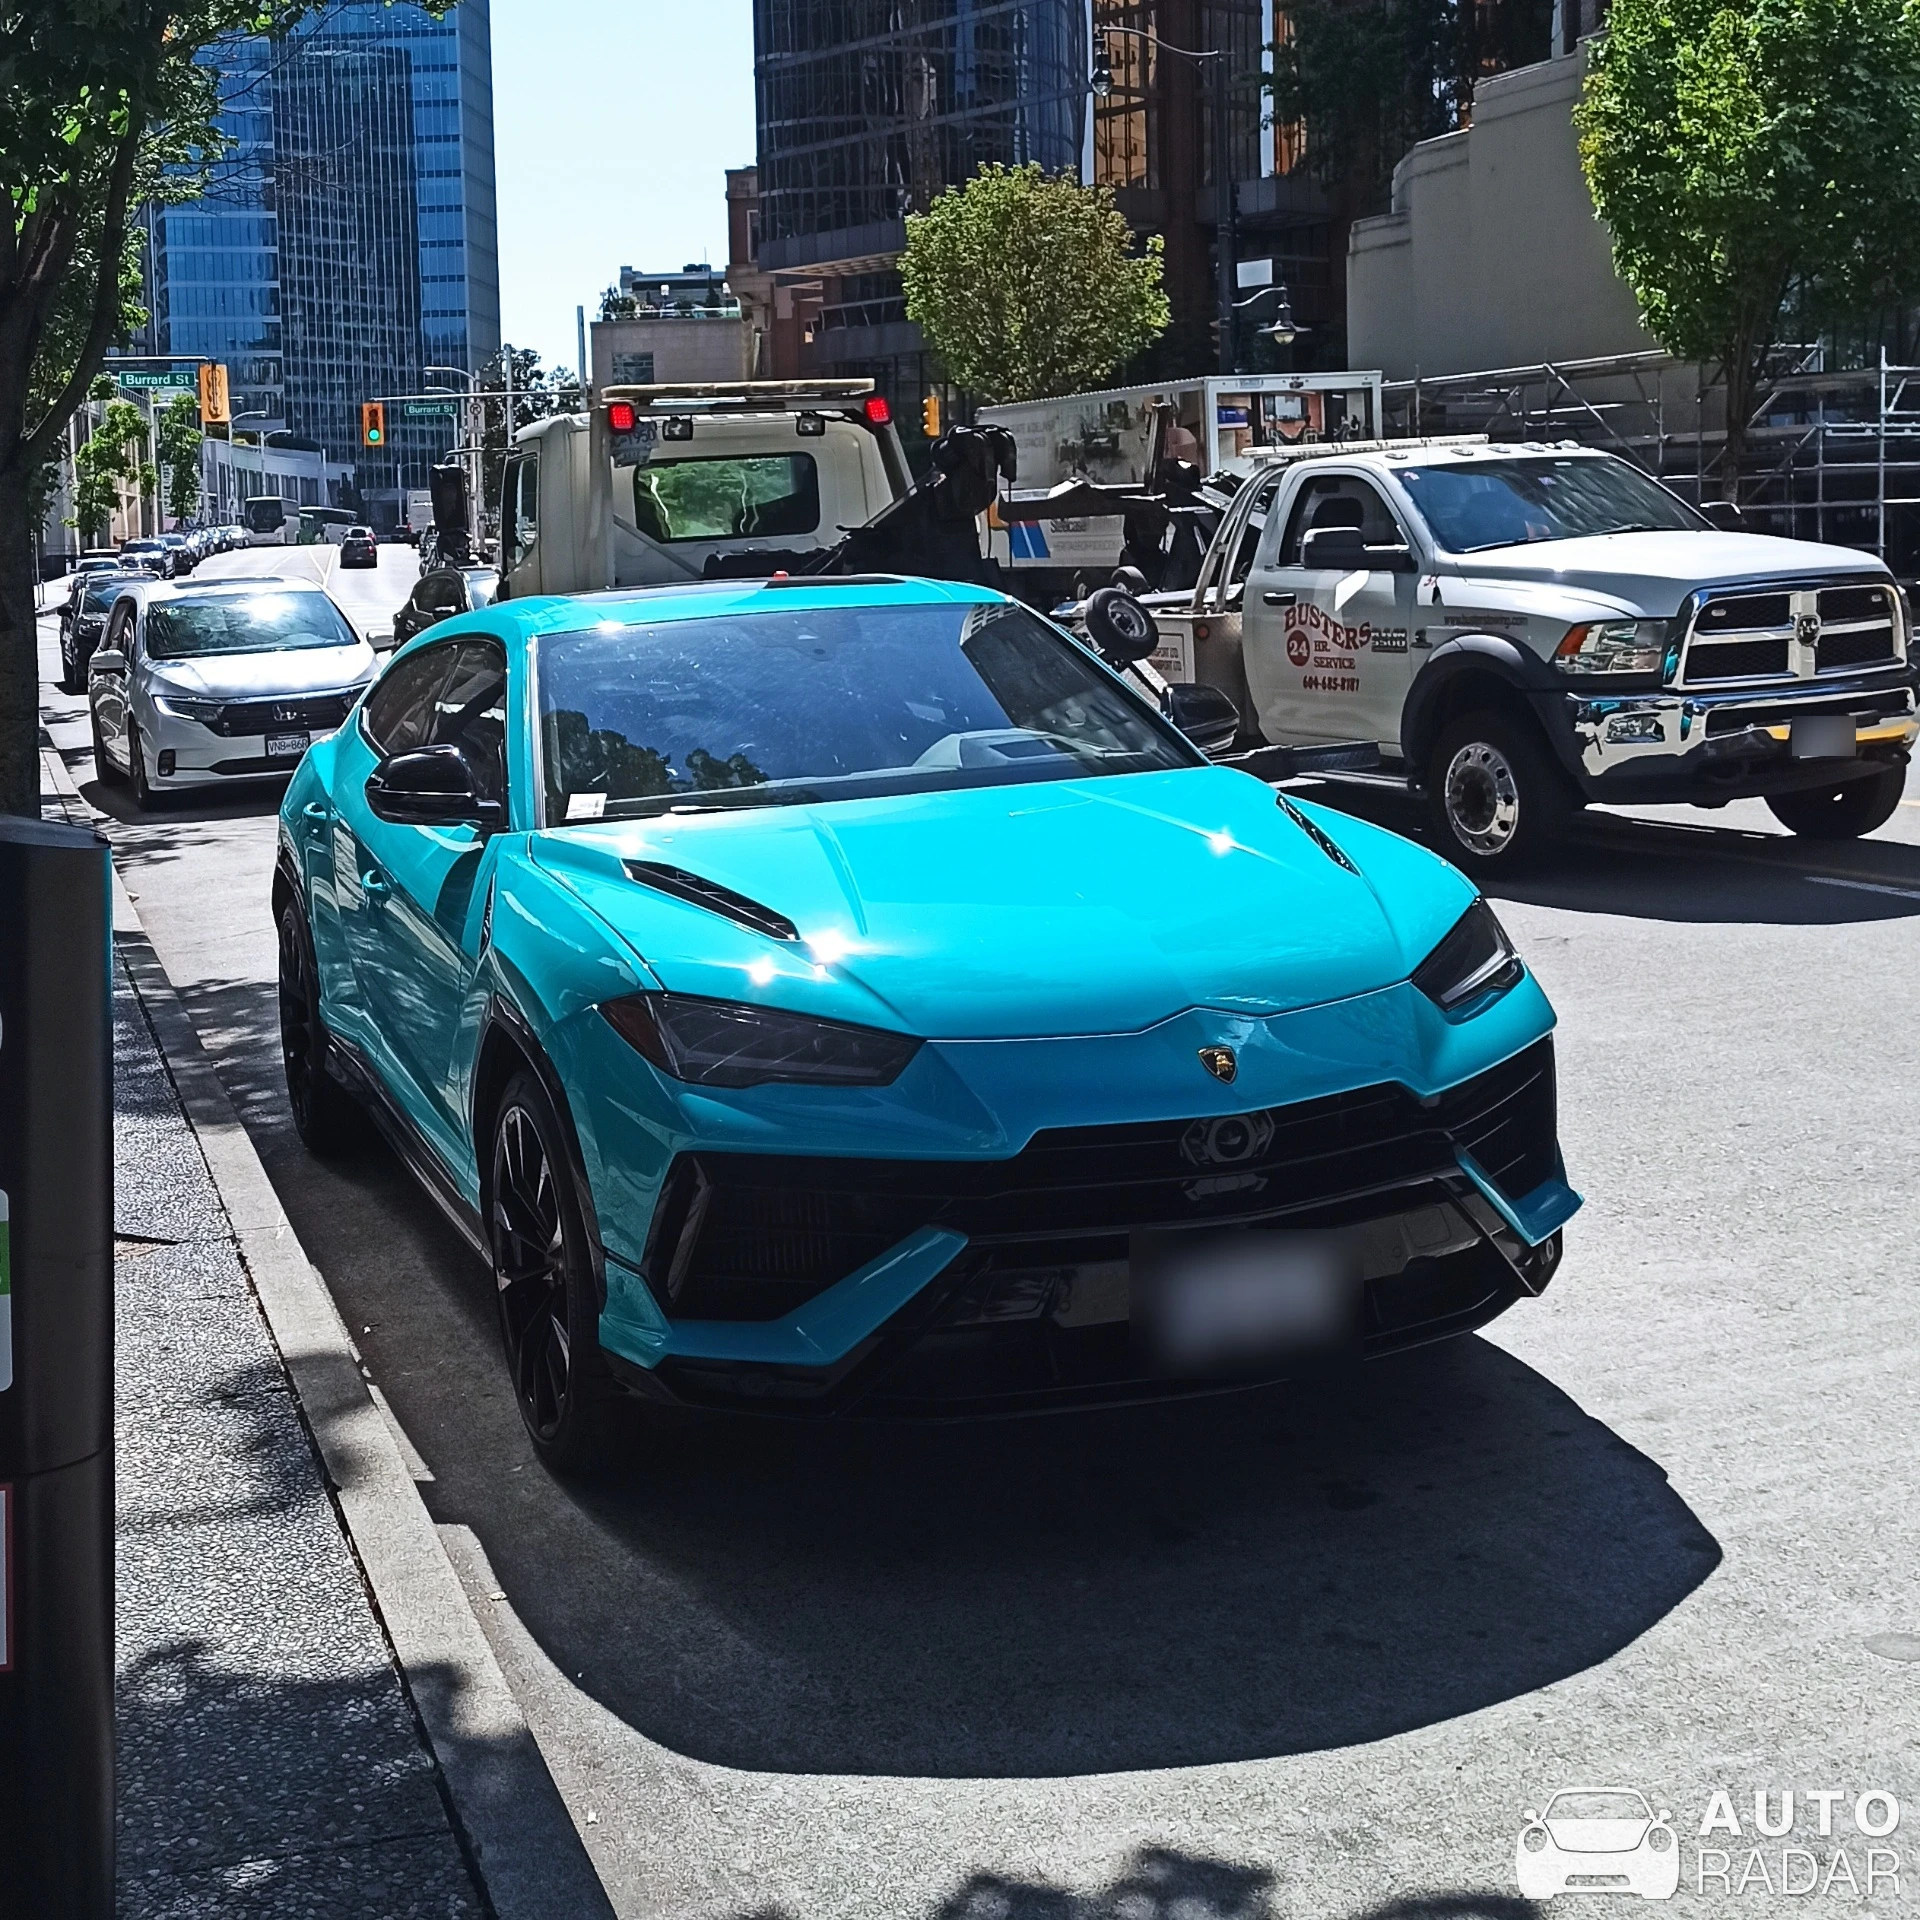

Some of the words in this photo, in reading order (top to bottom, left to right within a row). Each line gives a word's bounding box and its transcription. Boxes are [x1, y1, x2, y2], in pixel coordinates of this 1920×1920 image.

[125, 374, 170, 385] Burrard
[175, 374, 189, 385] St
[408, 405, 440, 414] Burrard
[443, 405, 453, 413] St
[1284, 603, 1371, 650] BUSTERS
[1289, 640, 1308, 657] 24
[1314, 657, 1356, 669] SERVICE
